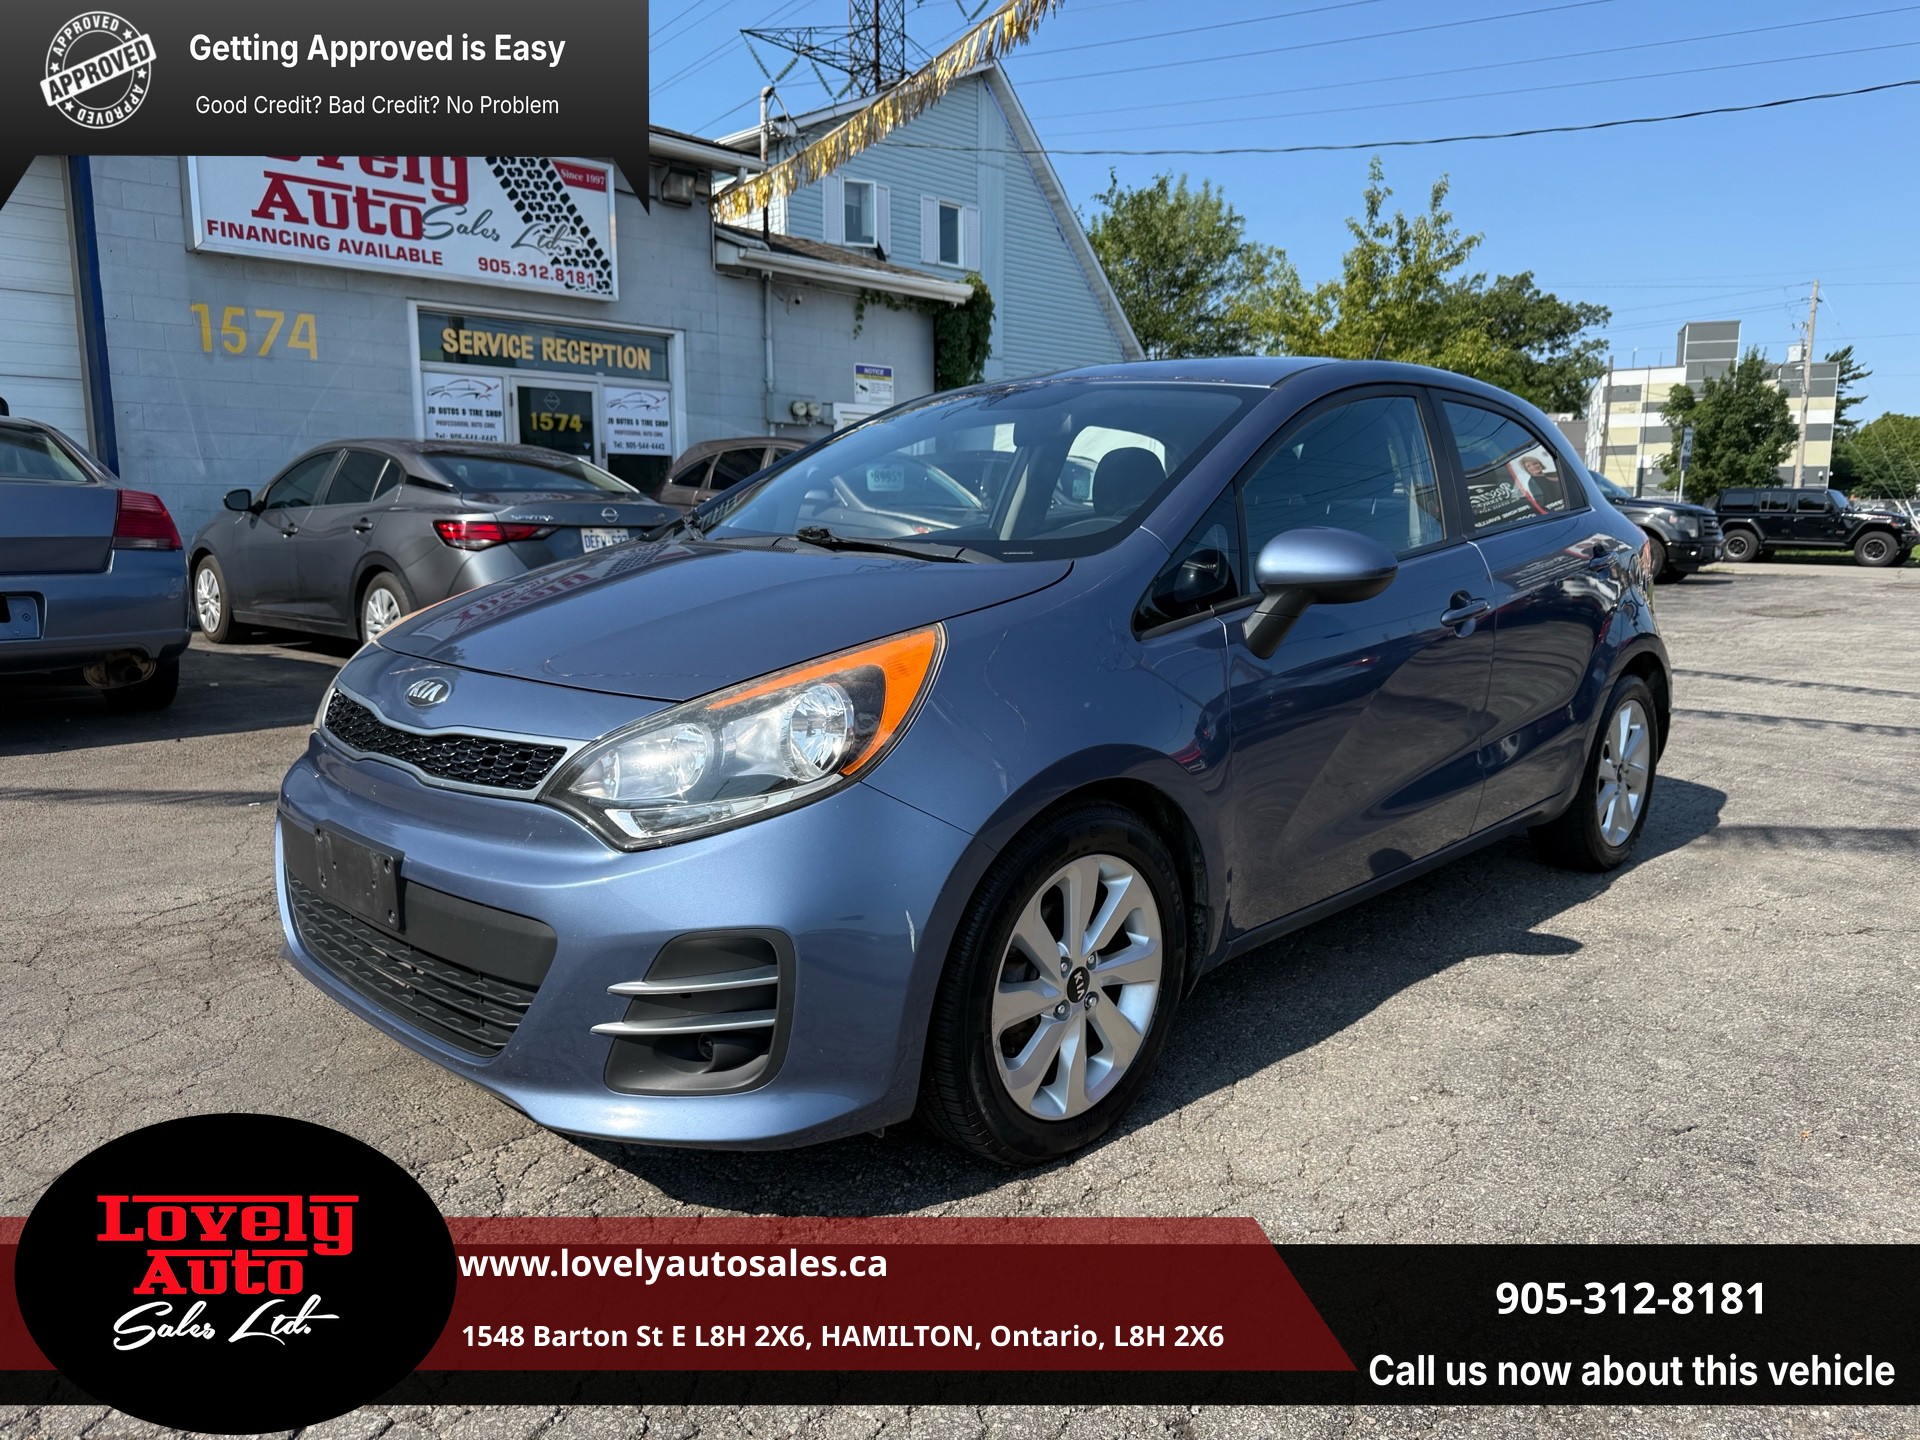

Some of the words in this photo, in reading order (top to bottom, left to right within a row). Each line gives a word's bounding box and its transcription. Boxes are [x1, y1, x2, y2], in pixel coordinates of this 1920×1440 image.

[560, 168, 584, 182] Since
[585, 173, 605, 185] 1997
[251, 170, 426, 241] Auto
[421, 203, 501, 242] Sales
[206, 218, 331, 252] FINANCING
[337, 238, 444, 267] AVAILABLE
[477, 256, 596, 287] 905.312.8181
[191, 303, 319, 361] 1574
[442, 327, 535, 361] SERVICE
[541, 336, 652, 372] RECEPTION
[863, 367, 885, 376] NOTICE
[530, 411, 583, 433] 1574
[408, 680, 444, 702] KIA
[1073, 970, 1086, 1001] KIA
